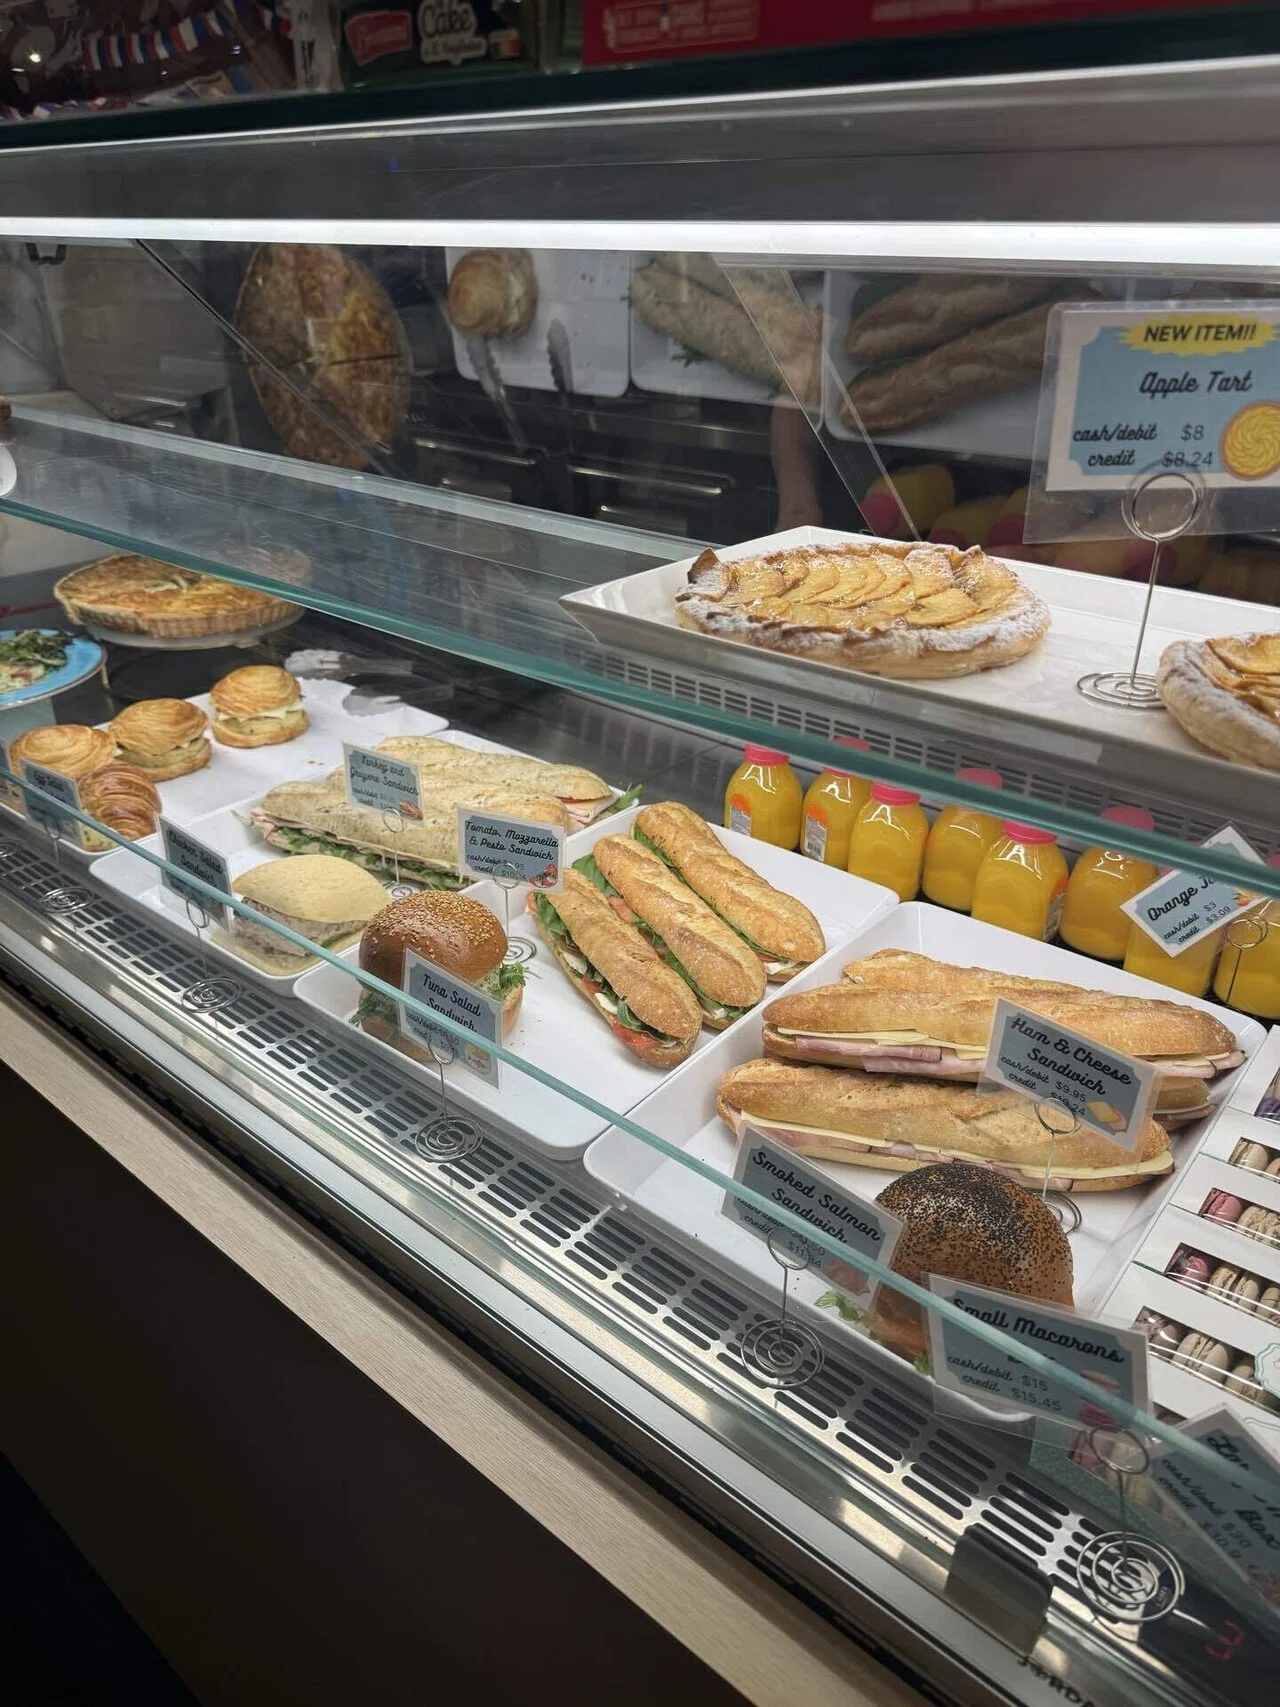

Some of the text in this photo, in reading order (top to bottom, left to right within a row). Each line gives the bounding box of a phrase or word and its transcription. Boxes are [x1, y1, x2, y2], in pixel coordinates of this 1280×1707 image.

[1143, 324, 1257, 342] NEW ITEM!!
[1139, 370, 1253, 399] Apple Tart
[1072, 423, 1205, 442] cash/debit $8
[1088, 450, 1213, 467] credit $8.24
[383, 776, 419, 796] Sandwich
[465, 821, 559, 848] Tomato, Mozzarella
[469, 836, 554, 860] & Pesto Sandwich
[474, 865, 493, 873] credit
[1147, 886, 1198, 921] Orange
[1163, 901, 1217, 940] cash/debit $3
[1178, 905, 1232, 943] credit $3.09
[423, 973, 481, 1017] Tuna Salad
[427, 997, 478, 1033] Sandwich
[1011, 1017, 1132, 1085] Ham & Cheese
[1001, 1055, 1087, 1103] cash/debit $9.95
[1008, 1073, 1037, 1091] credit
[1027, 1048, 1106, 1096] Sandwich
[752, 1151, 815, 1198] Smoked
[818, 1194, 881, 1241] Salmon
[743, 1215, 772, 1235] credit
[771, 1187, 848, 1243] Sandwich
[952, 1298, 1124, 1363] Small Macarons
[947, 1355, 1013, 1381] cash/debit
[1021, 1375, 1048, 1391] $15
[962, 1375, 1062, 1412] credit $15.45
